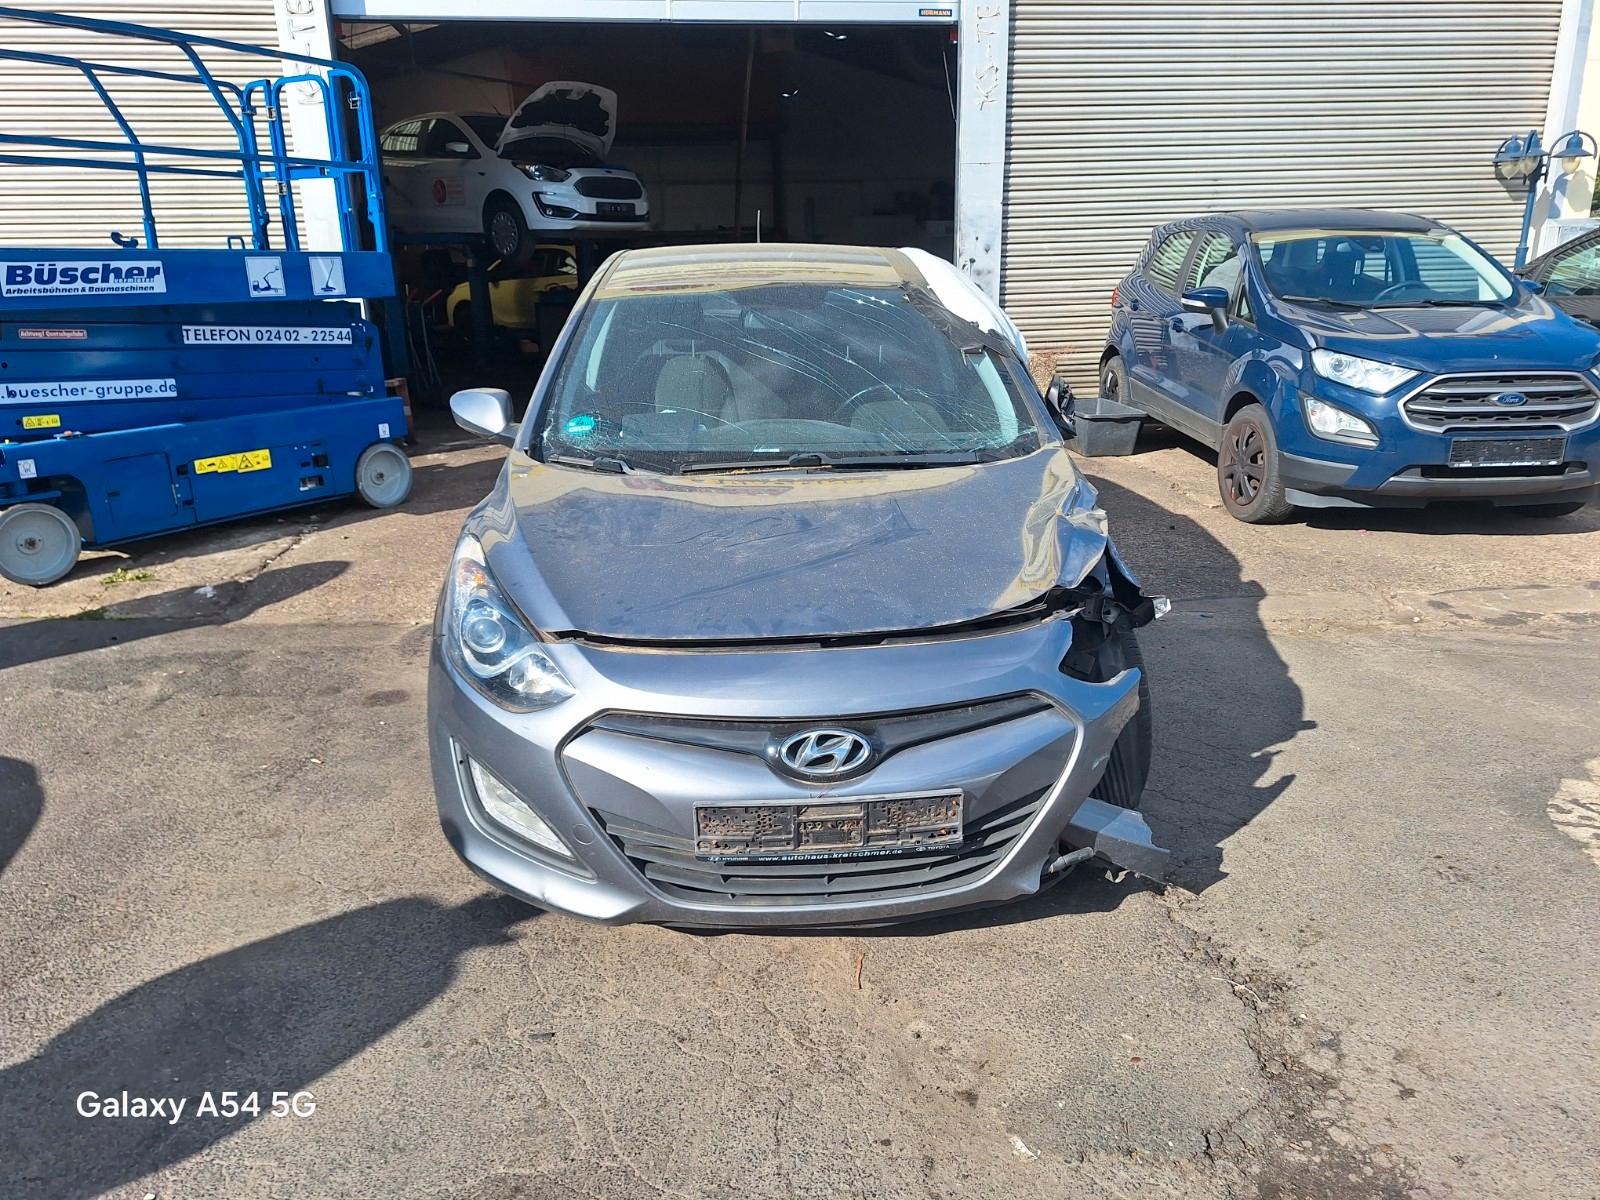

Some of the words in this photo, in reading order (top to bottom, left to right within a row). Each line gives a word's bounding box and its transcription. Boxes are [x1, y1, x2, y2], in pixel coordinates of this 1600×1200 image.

[5, 263, 161, 286] Büscher
[5, 286, 79, 295] Arbeitsbühnen
[88, 285, 155, 293] Baumaschinen
[183, 328, 250, 341] TELEFON
